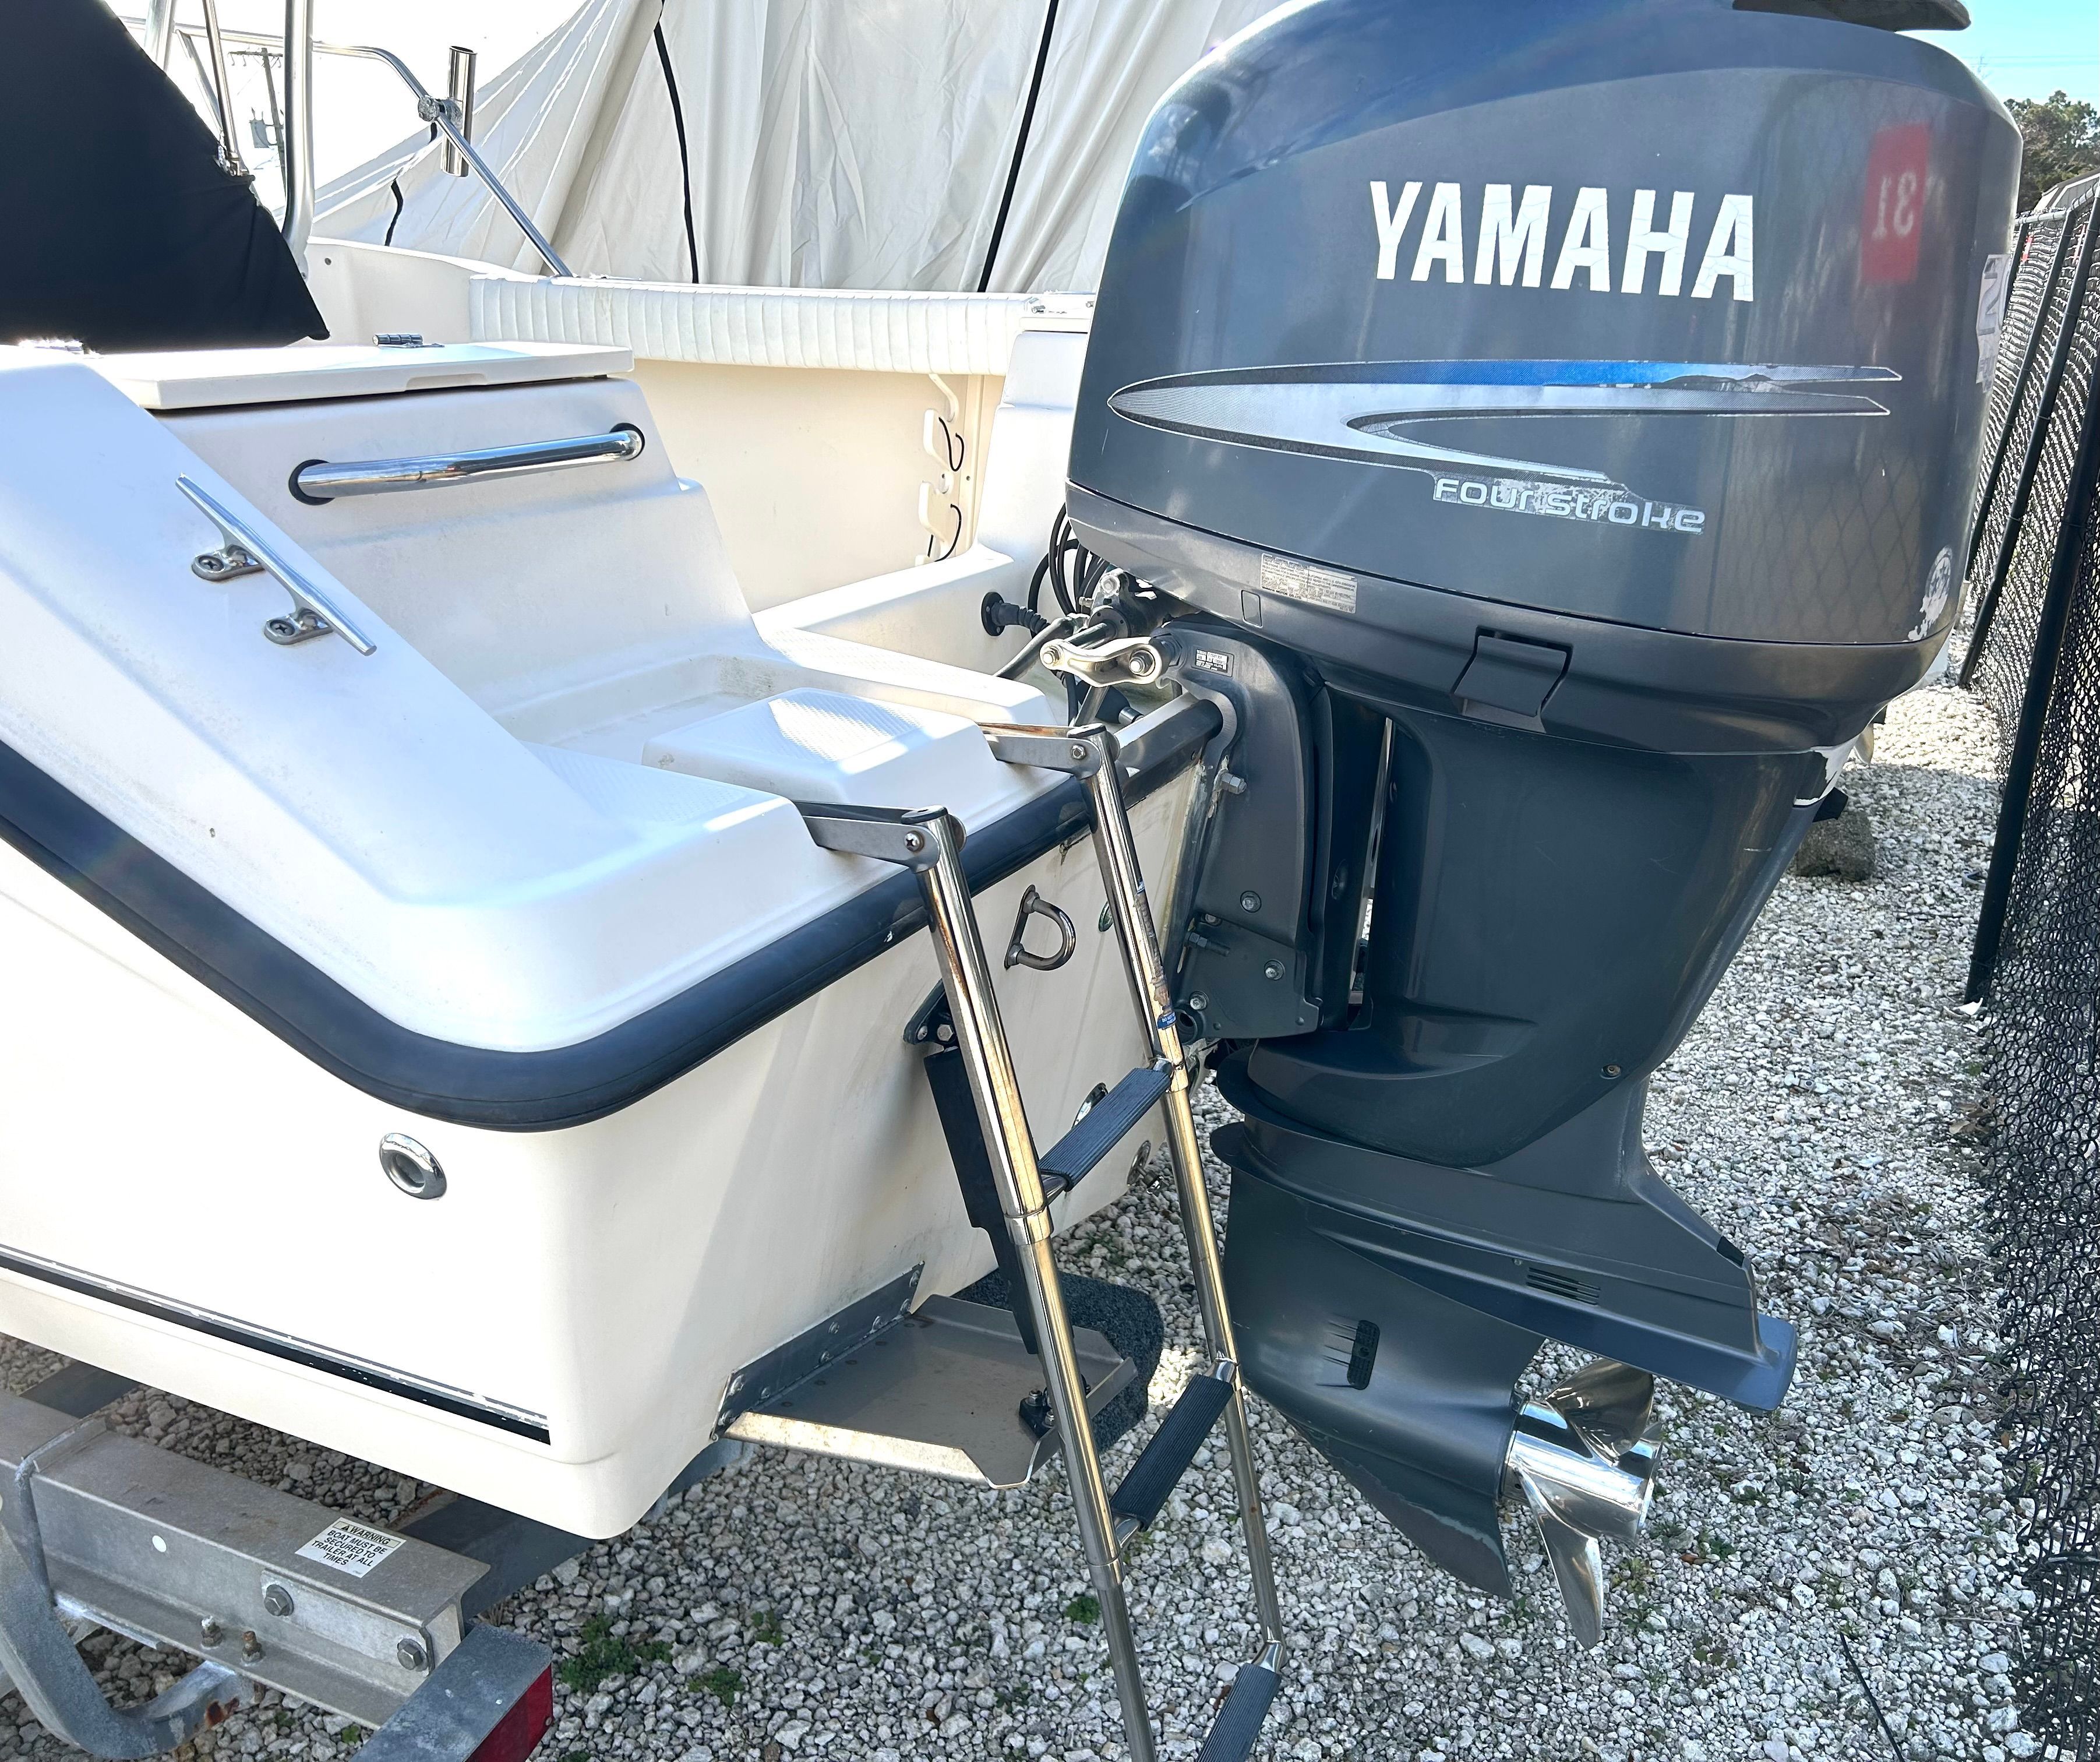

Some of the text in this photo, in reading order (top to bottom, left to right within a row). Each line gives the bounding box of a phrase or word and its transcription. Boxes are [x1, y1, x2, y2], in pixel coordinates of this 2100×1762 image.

[1370, 181, 1753, 302] YAMAHA
[327, 1530, 388, 1555] BOAT MUST BE
[350, 1525, 391, 1545] WARNING
[311, 1540, 347, 1558] TRAILER
[357, 1557, 373, 1567] ALL
[323, 1553, 349, 1566] TIMES
[324, 1537, 376, 1559] SECURED TO
